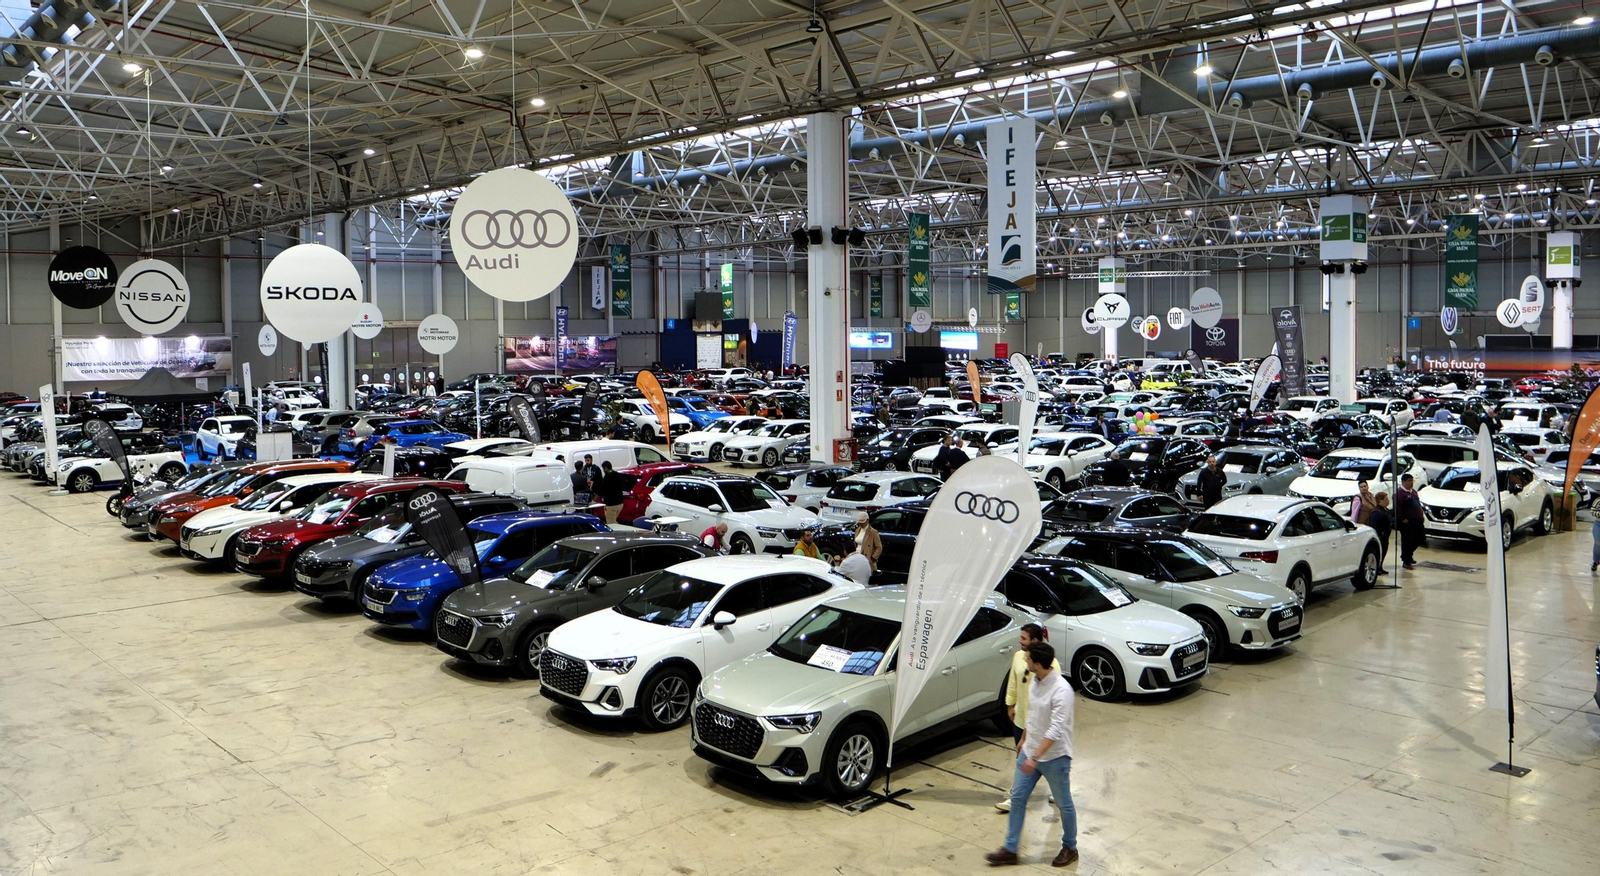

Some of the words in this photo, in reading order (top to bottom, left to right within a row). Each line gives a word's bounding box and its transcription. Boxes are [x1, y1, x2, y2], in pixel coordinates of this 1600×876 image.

[1005, 127, 1018, 230] IFEJA
[465, 254, 520, 271] Audi
[120, 291, 186, 303] NISSAN
[1522, 305, 1541, 314] SEAT
[1169, 312, 1183, 325] FIAT
[1428, 360, 1448, 369] The
[1450, 360, 1486, 369] future
[916, 610, 933, 670] Espawagen
